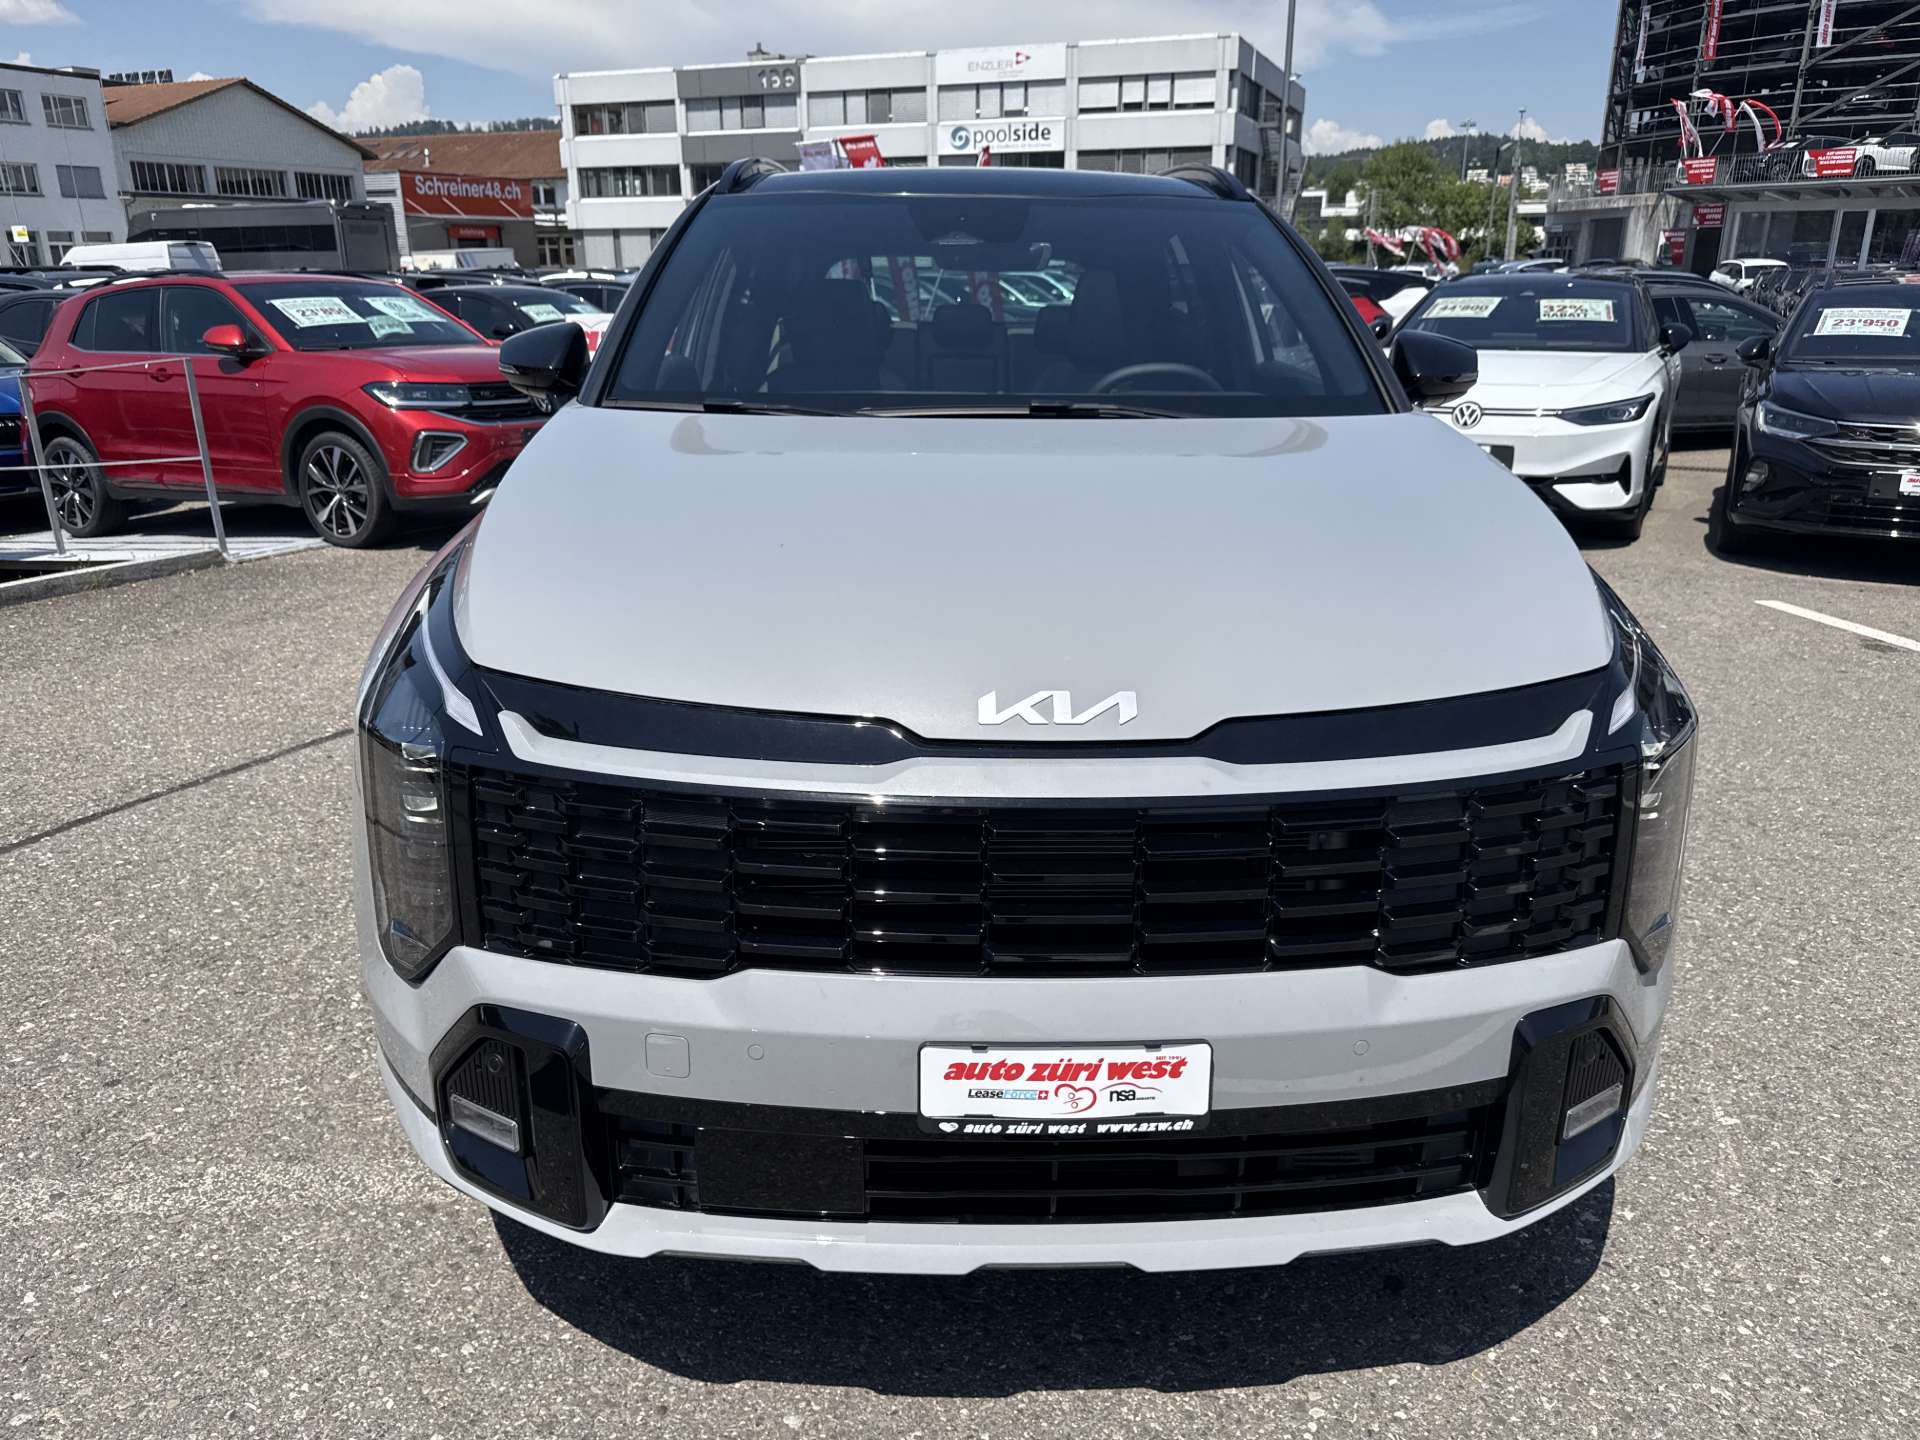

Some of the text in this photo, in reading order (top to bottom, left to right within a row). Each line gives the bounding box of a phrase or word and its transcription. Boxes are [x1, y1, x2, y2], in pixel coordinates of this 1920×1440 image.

[967, 59, 1014, 73] ENZLER
[973, 121, 1052, 150] poolside
[415, 175, 522, 199] Schreiner48.ch
[1832, 318, 1900, 328] 23'950
[977, 690, 1138, 726] KIA
[943, 1057, 1189, 1082] auto züri west
[967, 1088, 1037, 1100] LeaseForce
[1109, 1089, 1136, 1102] nsa
[963, 1119, 1194, 1134] auto züri west www.azw.ch
